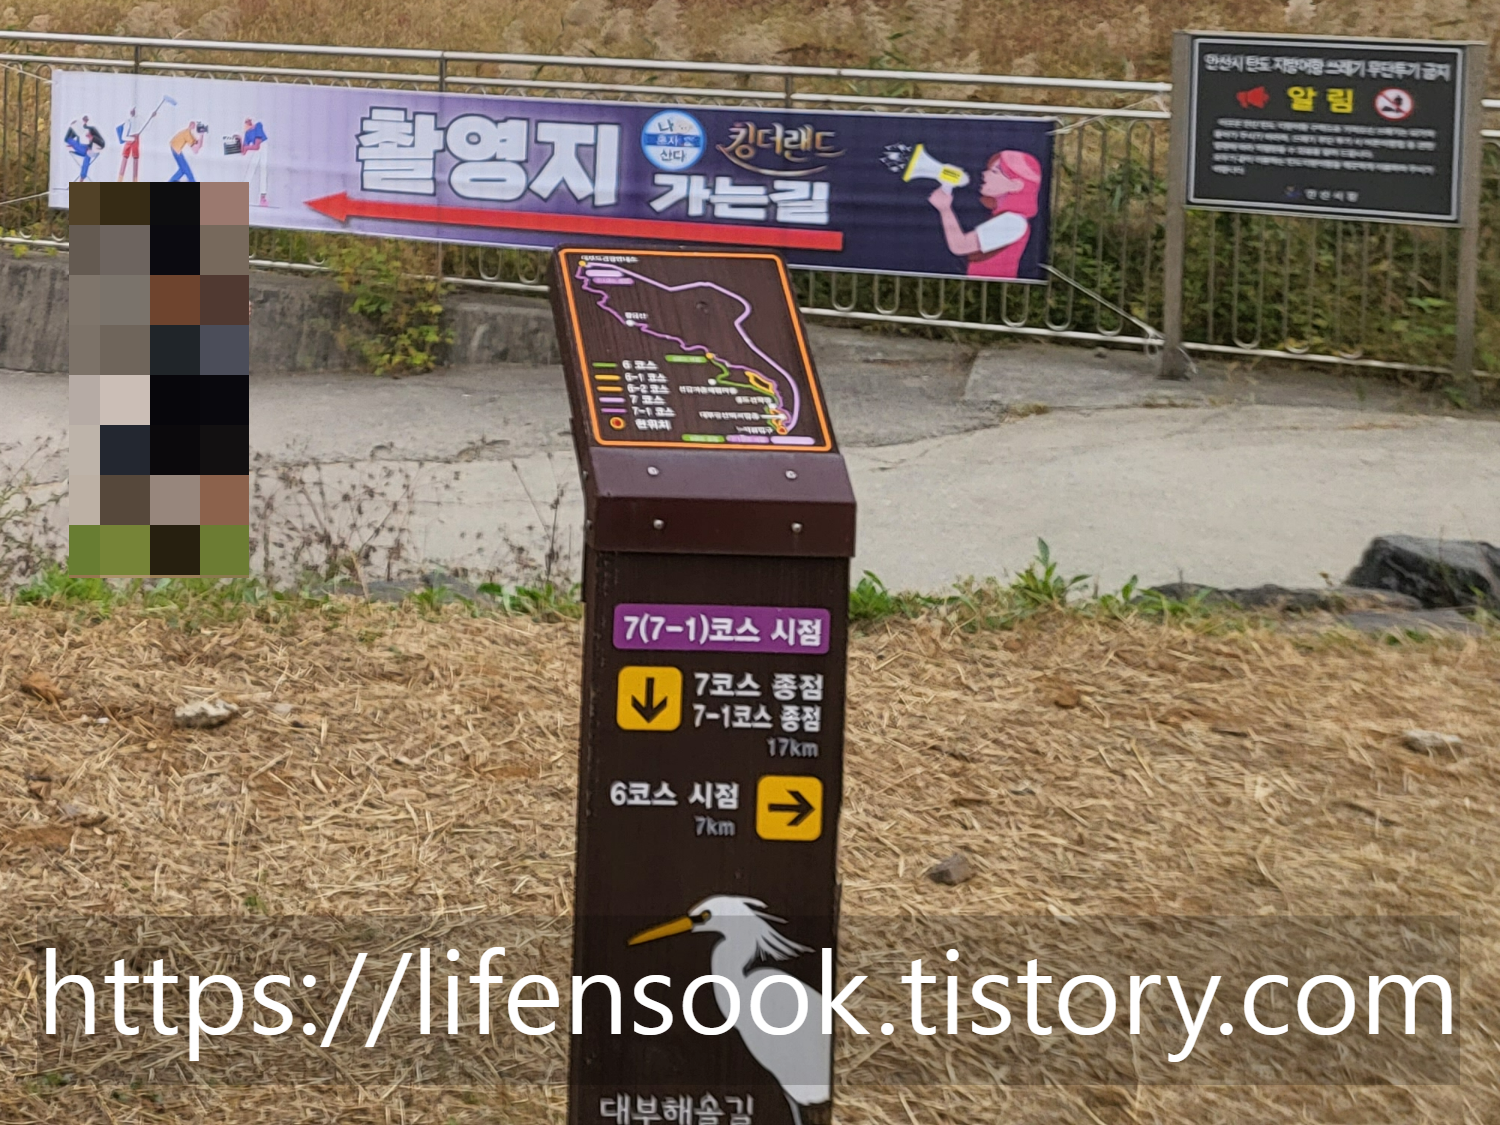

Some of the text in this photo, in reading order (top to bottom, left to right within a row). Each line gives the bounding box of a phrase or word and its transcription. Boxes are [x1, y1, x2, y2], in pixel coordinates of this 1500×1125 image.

[658, 118, 674, 132] 나
[357, 108, 621, 205] 촬영지
[660, 149, 687, 162] 산다
[717, 121, 847, 174] 킹더랜드
[649, 173, 830, 225] 가는길
[623, 613, 822, 647] 7(7-1)코스 시점
[694, 672, 823, 701] 7코스 종점
[692, 704, 821, 732] 7-1코스 종점
[767, 737, 818, 757] 17km
[610, 781, 739, 810] 6코스 시점
[694, 816, 735, 836] 7km
[600, 1091, 754, 1125] 대부해솔길
